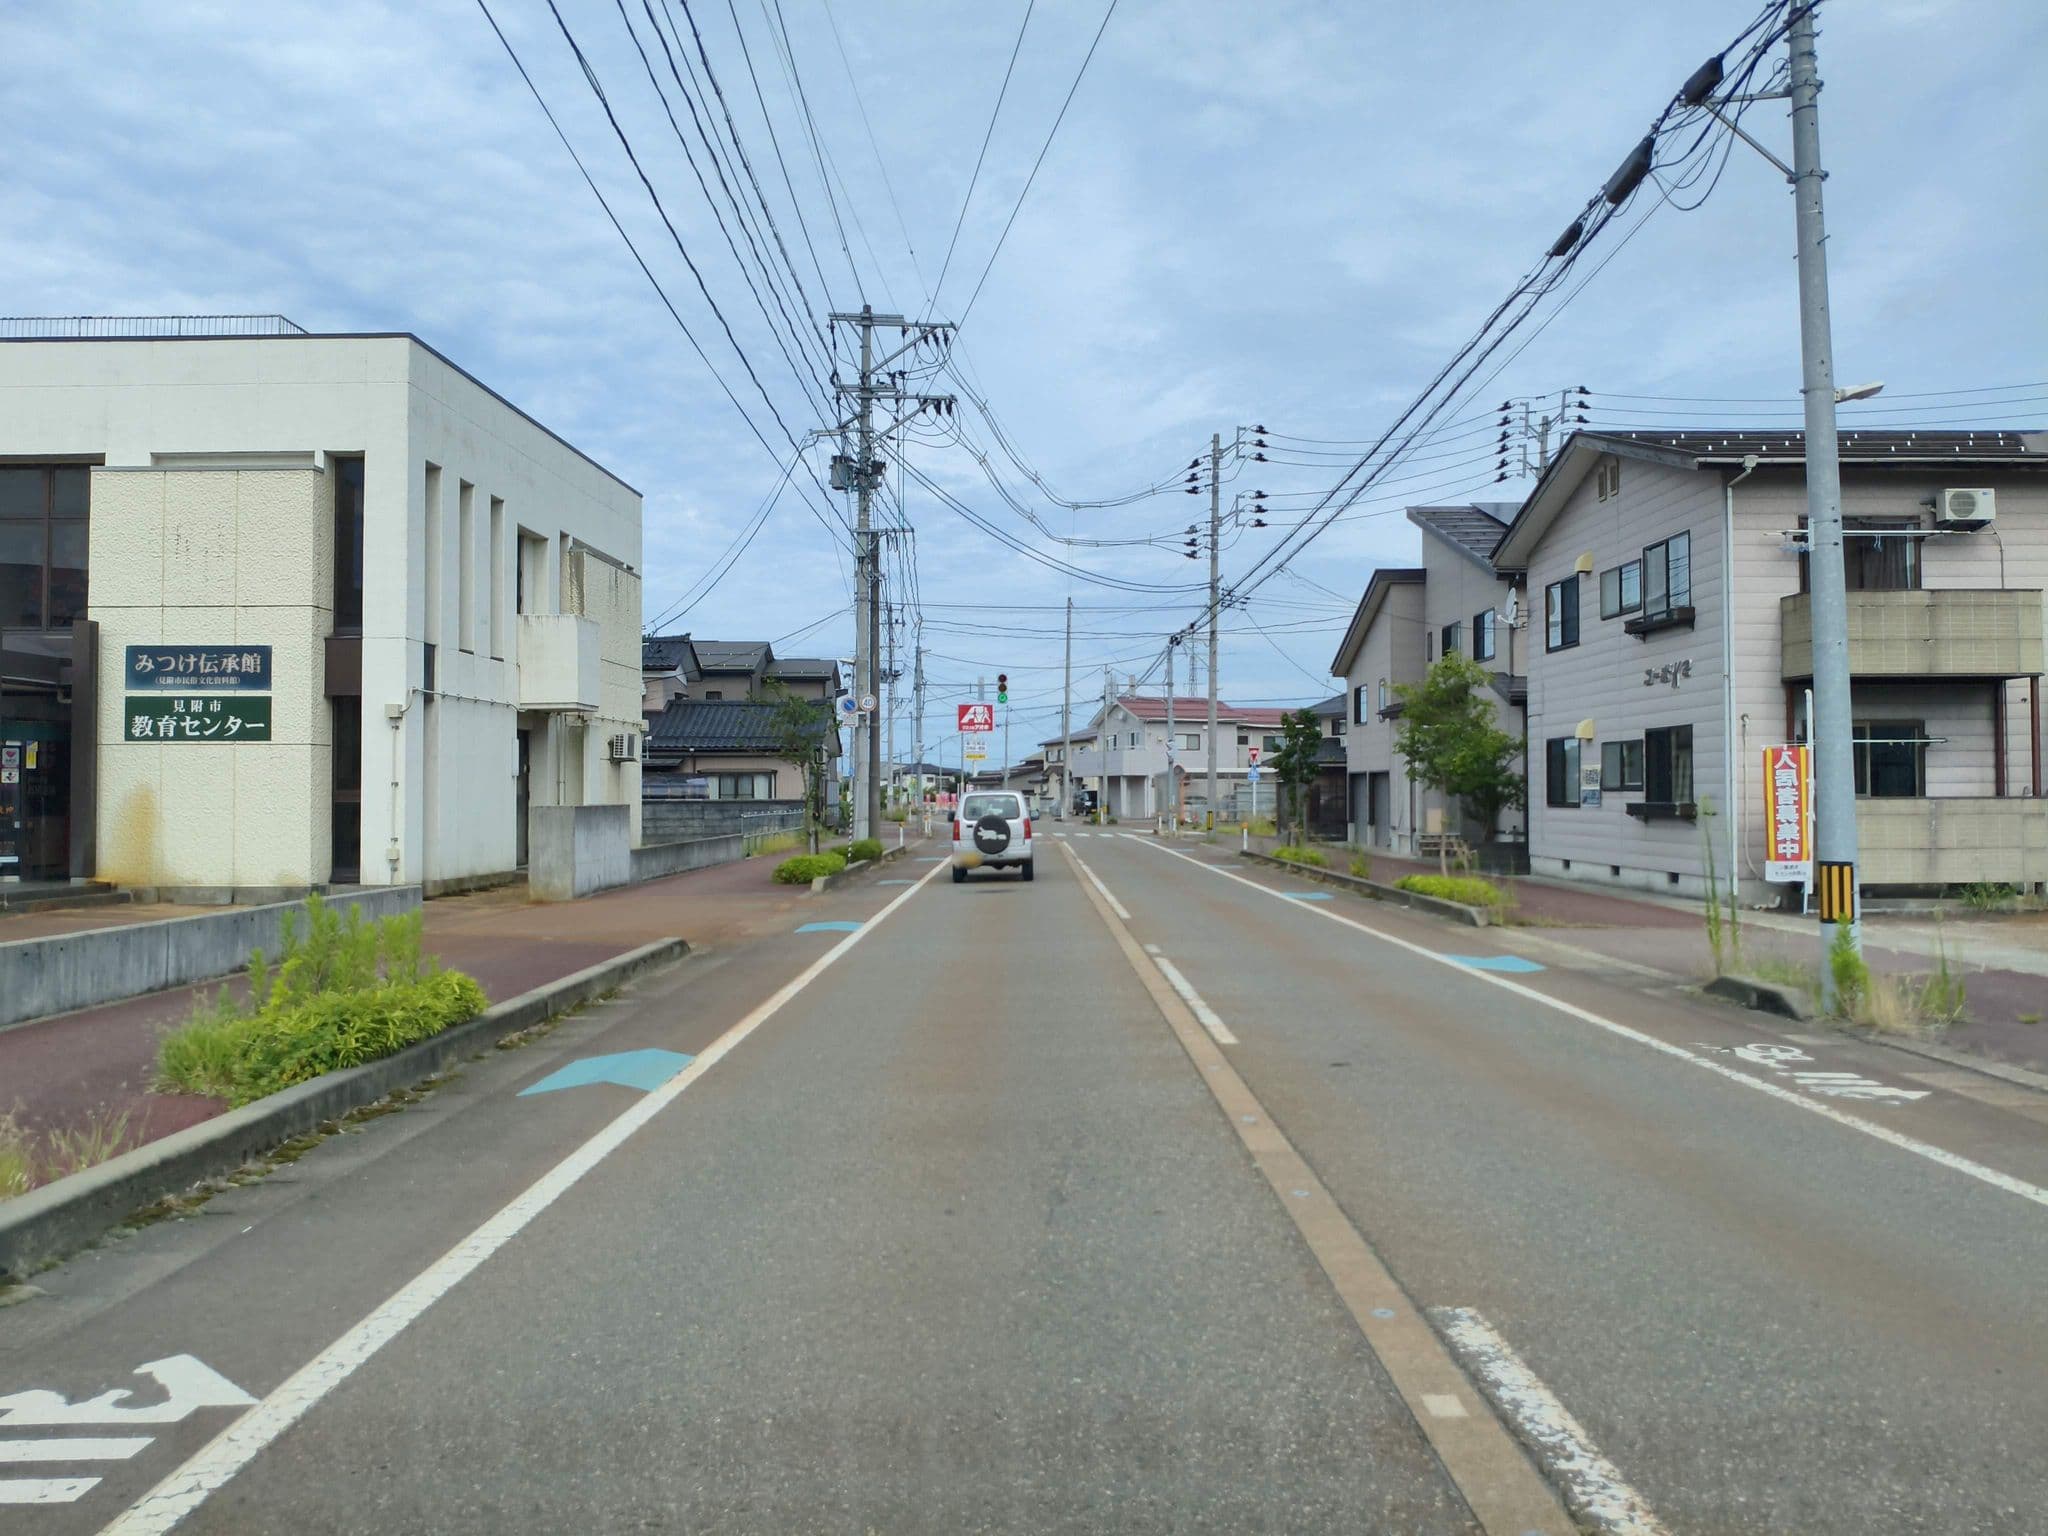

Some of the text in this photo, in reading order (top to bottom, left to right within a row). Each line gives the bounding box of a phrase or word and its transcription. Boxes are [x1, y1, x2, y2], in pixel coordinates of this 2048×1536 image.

[135, 653, 262, 674] みつけ伝承館
[173, 699, 222, 713] 見附市
[131, 715, 265, 738] 教育センター
